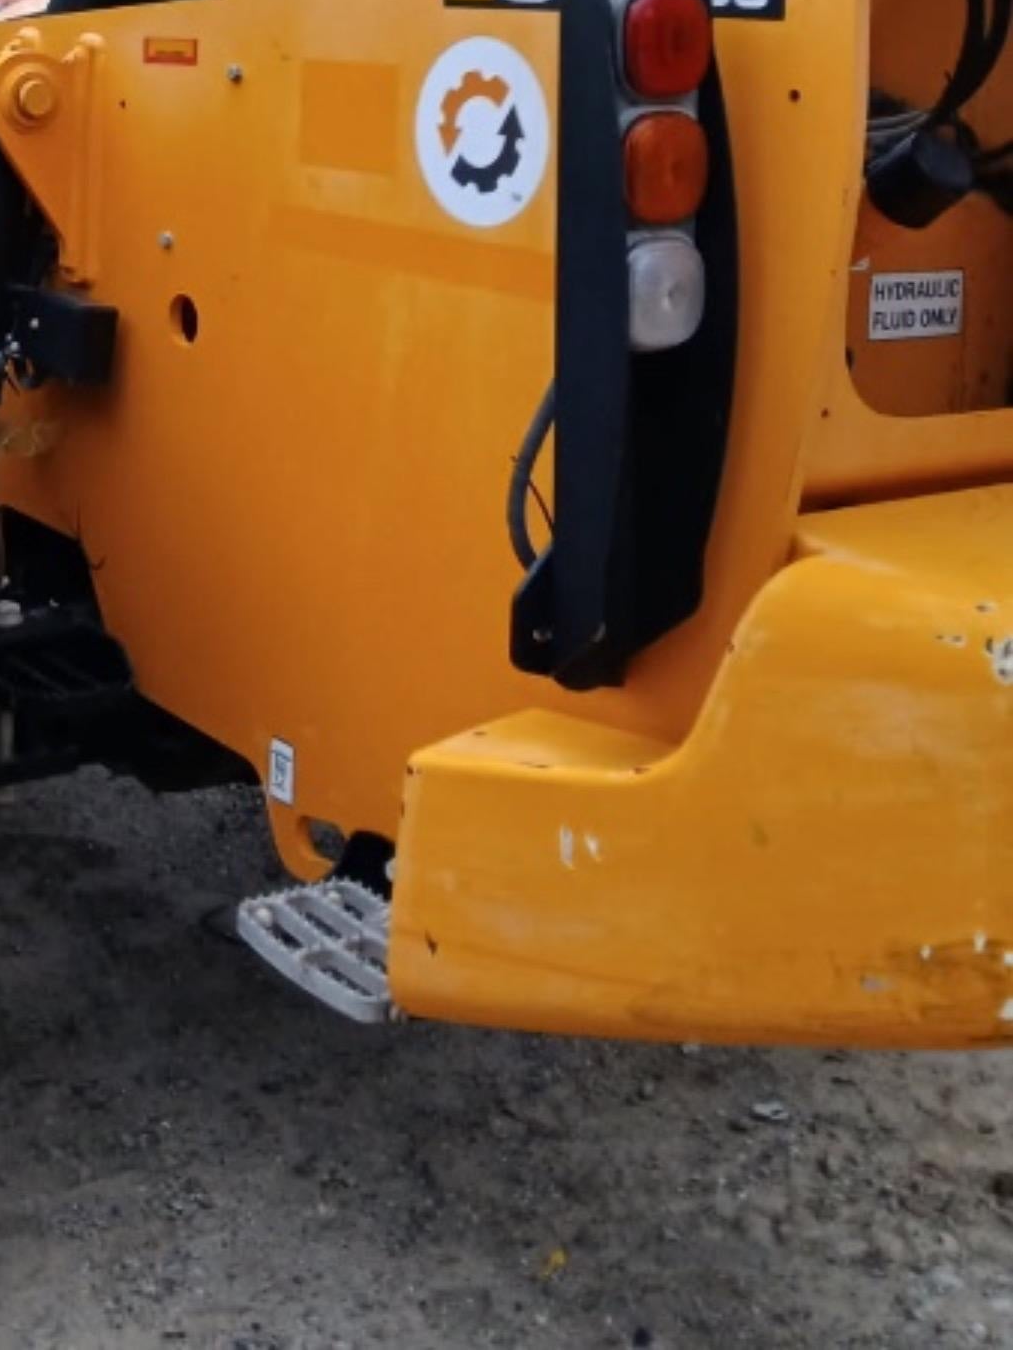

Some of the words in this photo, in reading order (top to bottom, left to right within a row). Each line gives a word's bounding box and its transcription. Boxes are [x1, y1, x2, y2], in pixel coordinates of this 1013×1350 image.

[875, 278, 960, 301] HYDRAULIC
[873, 311, 916, 331] FLUID
[920, 307, 958, 328] ONLY
